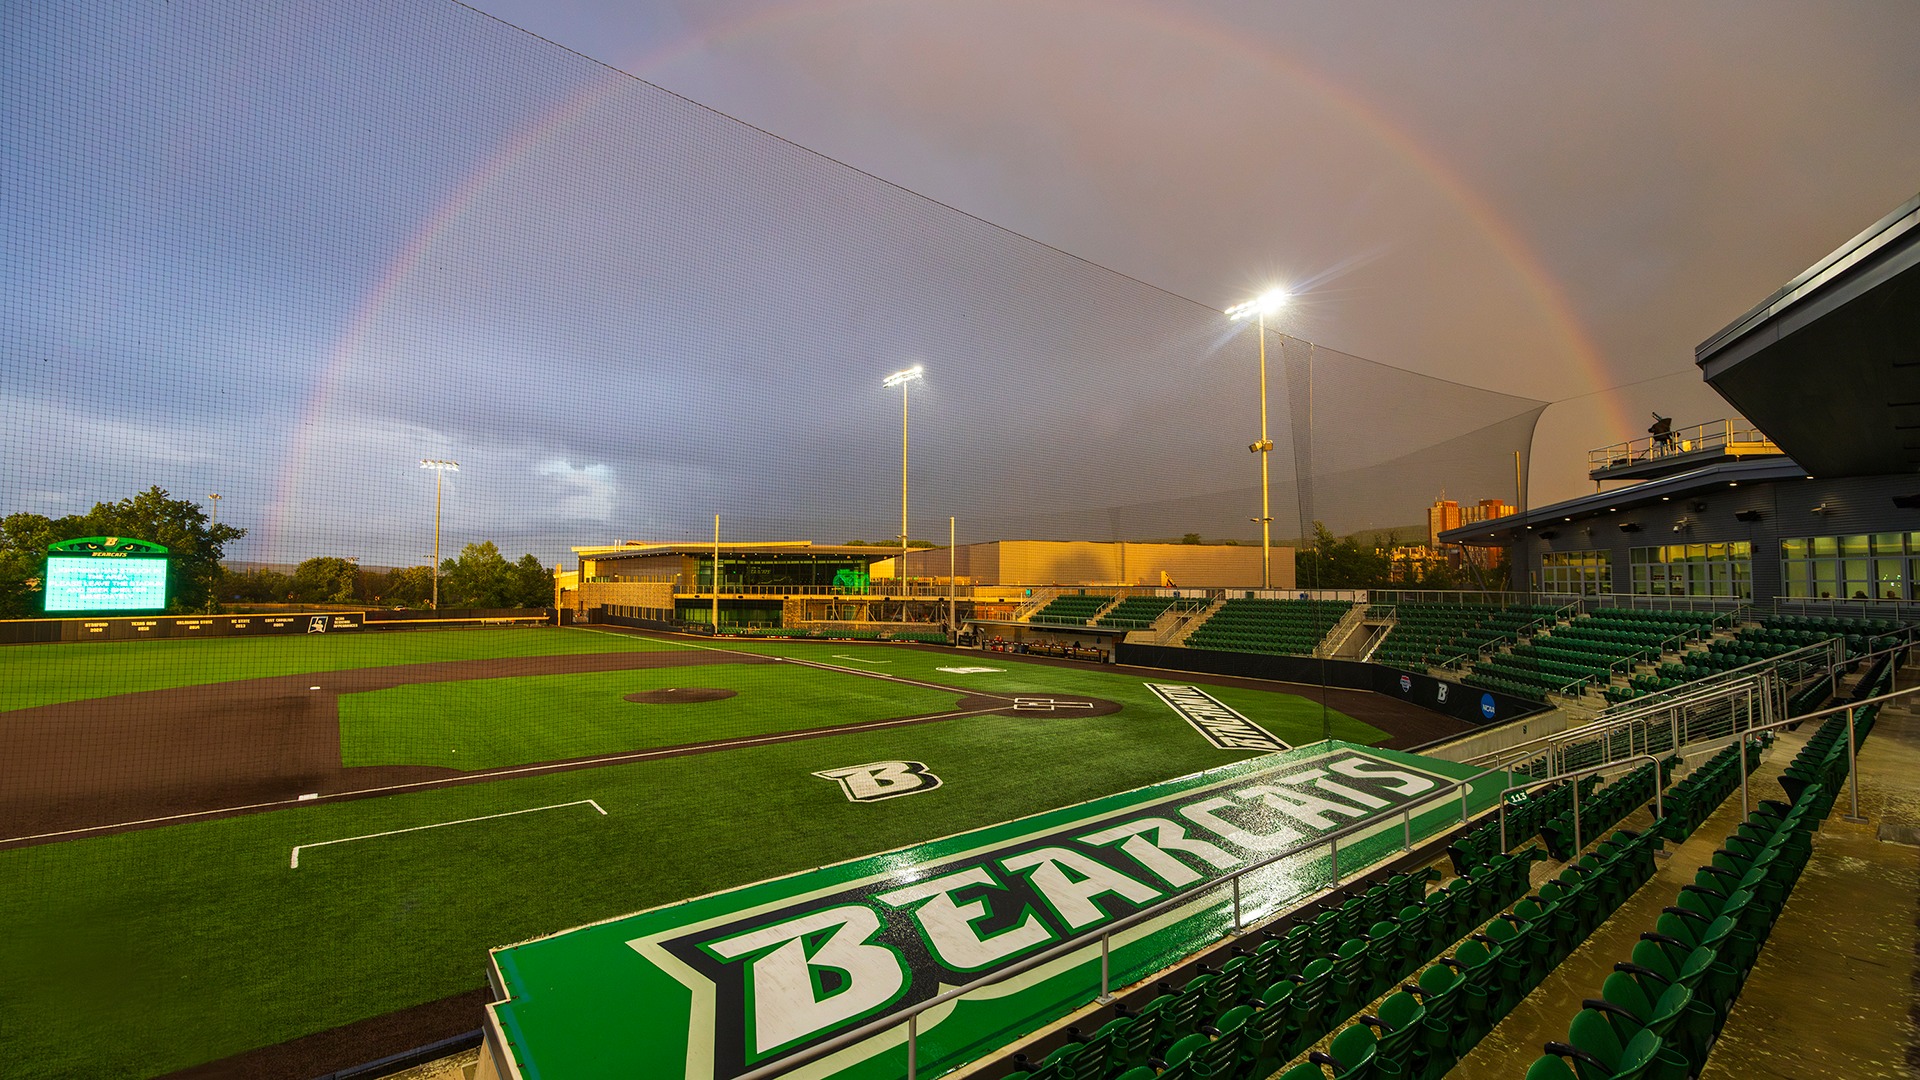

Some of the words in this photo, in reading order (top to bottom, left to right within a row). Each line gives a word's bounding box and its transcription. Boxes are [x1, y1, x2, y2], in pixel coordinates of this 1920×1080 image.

[104, 537, 118, 546] B
[1437, 682, 1448, 702] B
[1482, 704, 1496, 714] NCAA
[814, 761, 941, 801] B
[1511, 792, 1527, 802] 113
[702, 757, 1437, 1058] BEARCATS
